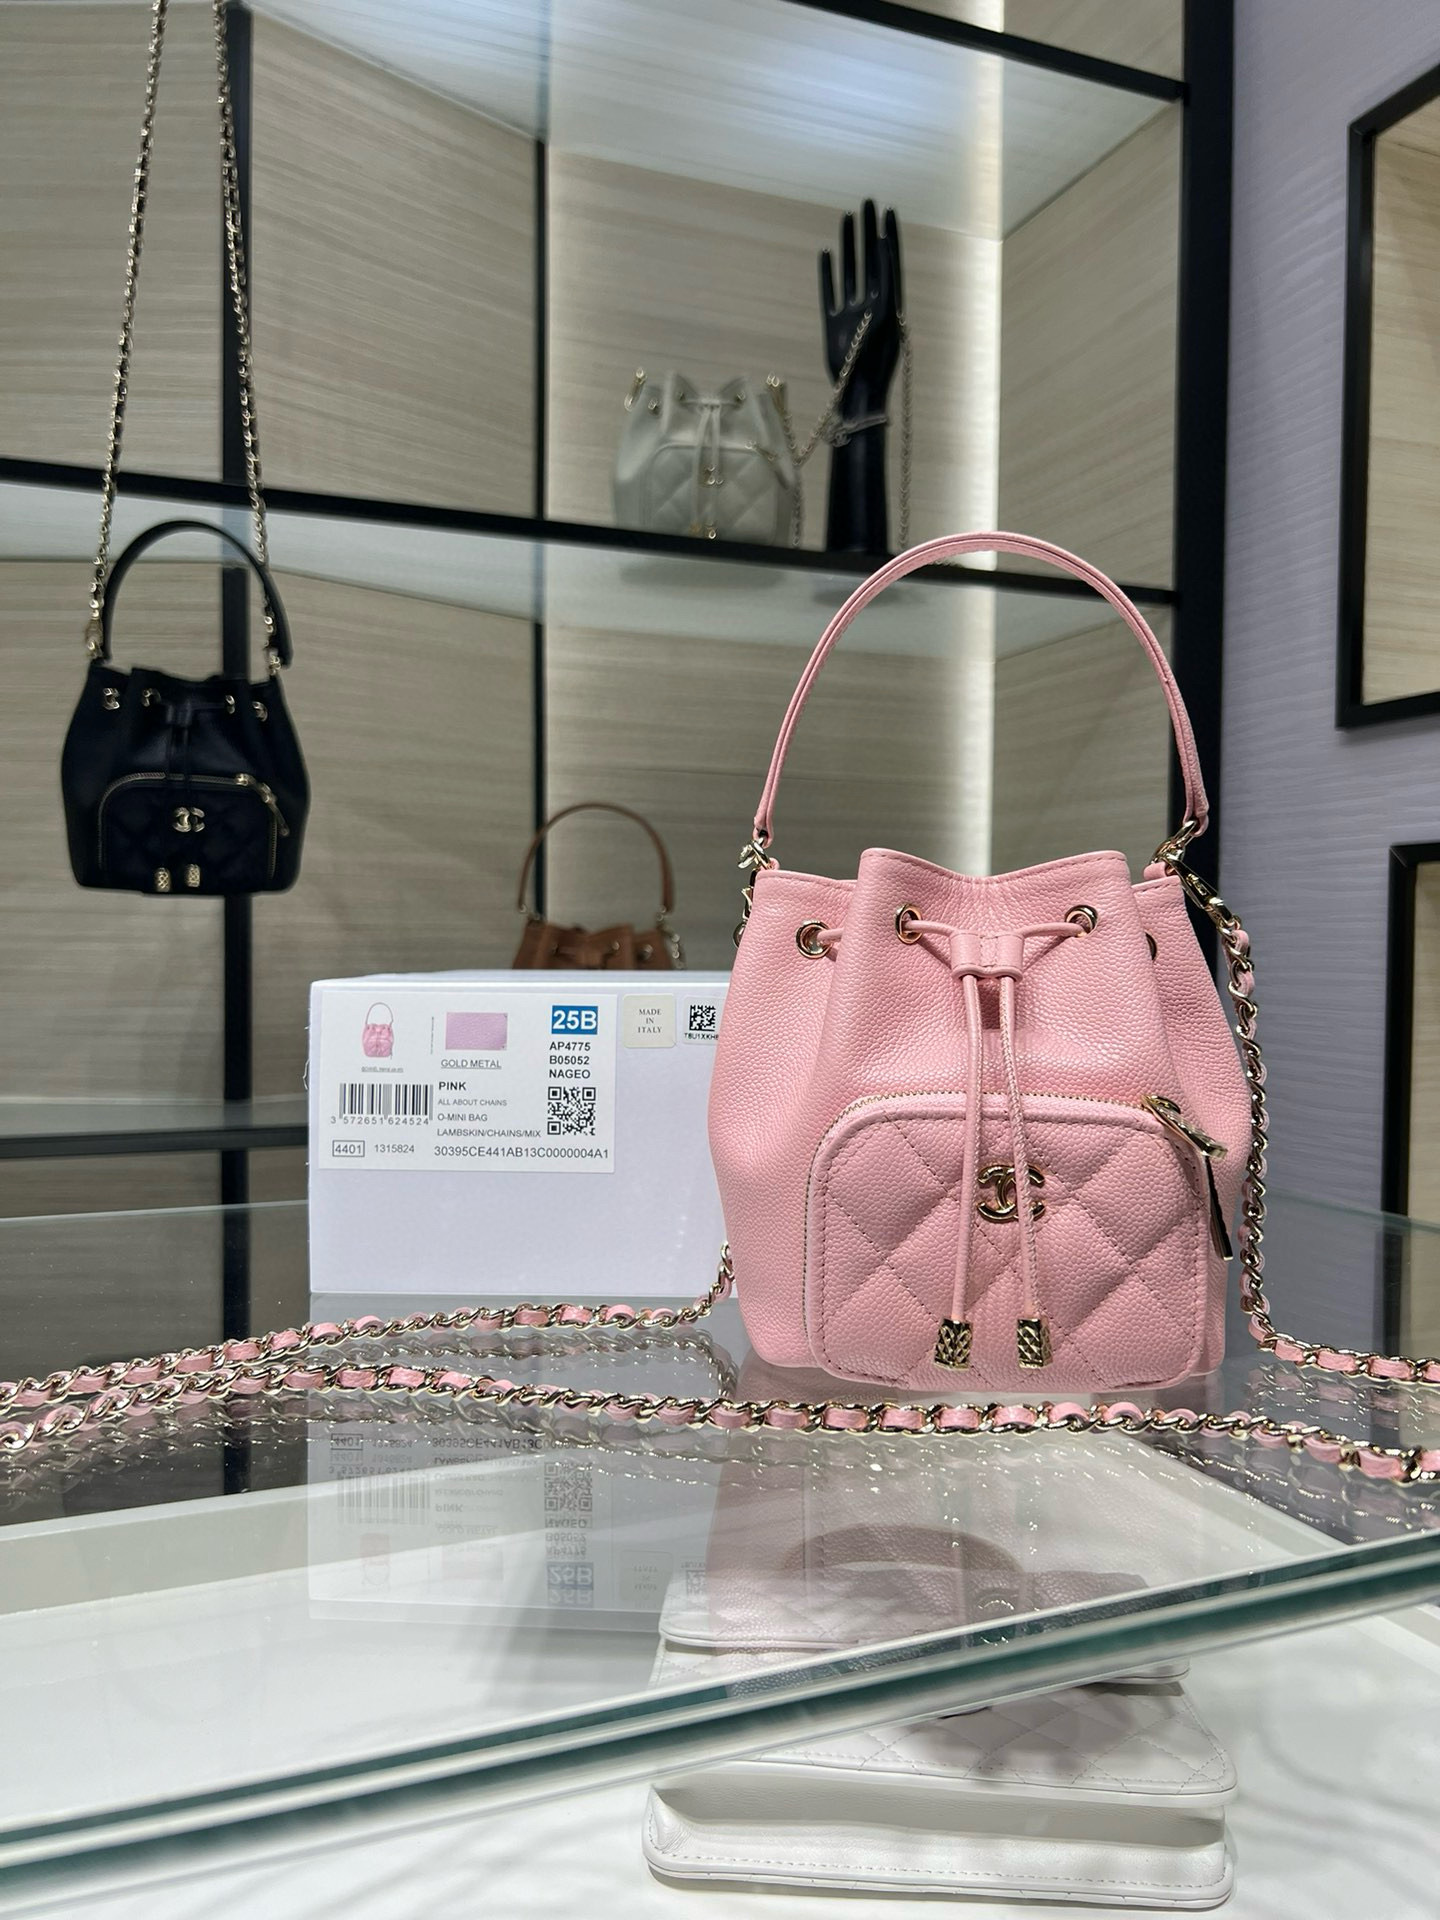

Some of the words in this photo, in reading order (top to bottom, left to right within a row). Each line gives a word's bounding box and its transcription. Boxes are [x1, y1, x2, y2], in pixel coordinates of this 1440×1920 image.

[552, 1010, 598, 1030] 25B
[549, 1041, 591, 1051] AP4775
[440, 1058, 468, 1069] GOLD
[470, 1059, 502, 1069] METAL
[549, 1055, 590, 1065] B05052
[549, 1069, 591, 1079] NAGEO
[438, 1081, 467, 1091] PINK
[330, 1116, 337, 1124] 3
[343, 1116, 384, 1125] 572651
[388, 1117, 429, 1125] 624524
[437, 1113, 467, 1122] O-MINI
[468, 1113, 488, 1122] BAG
[437, 1128, 542, 1138] LAMBSKIN/CHAINS/MIX
[335, 1144, 361, 1154] 4401
[374, 1144, 415, 1153] 1315824
[434, 1146, 609, 1159] 30395CE441AB13C0000004A1
